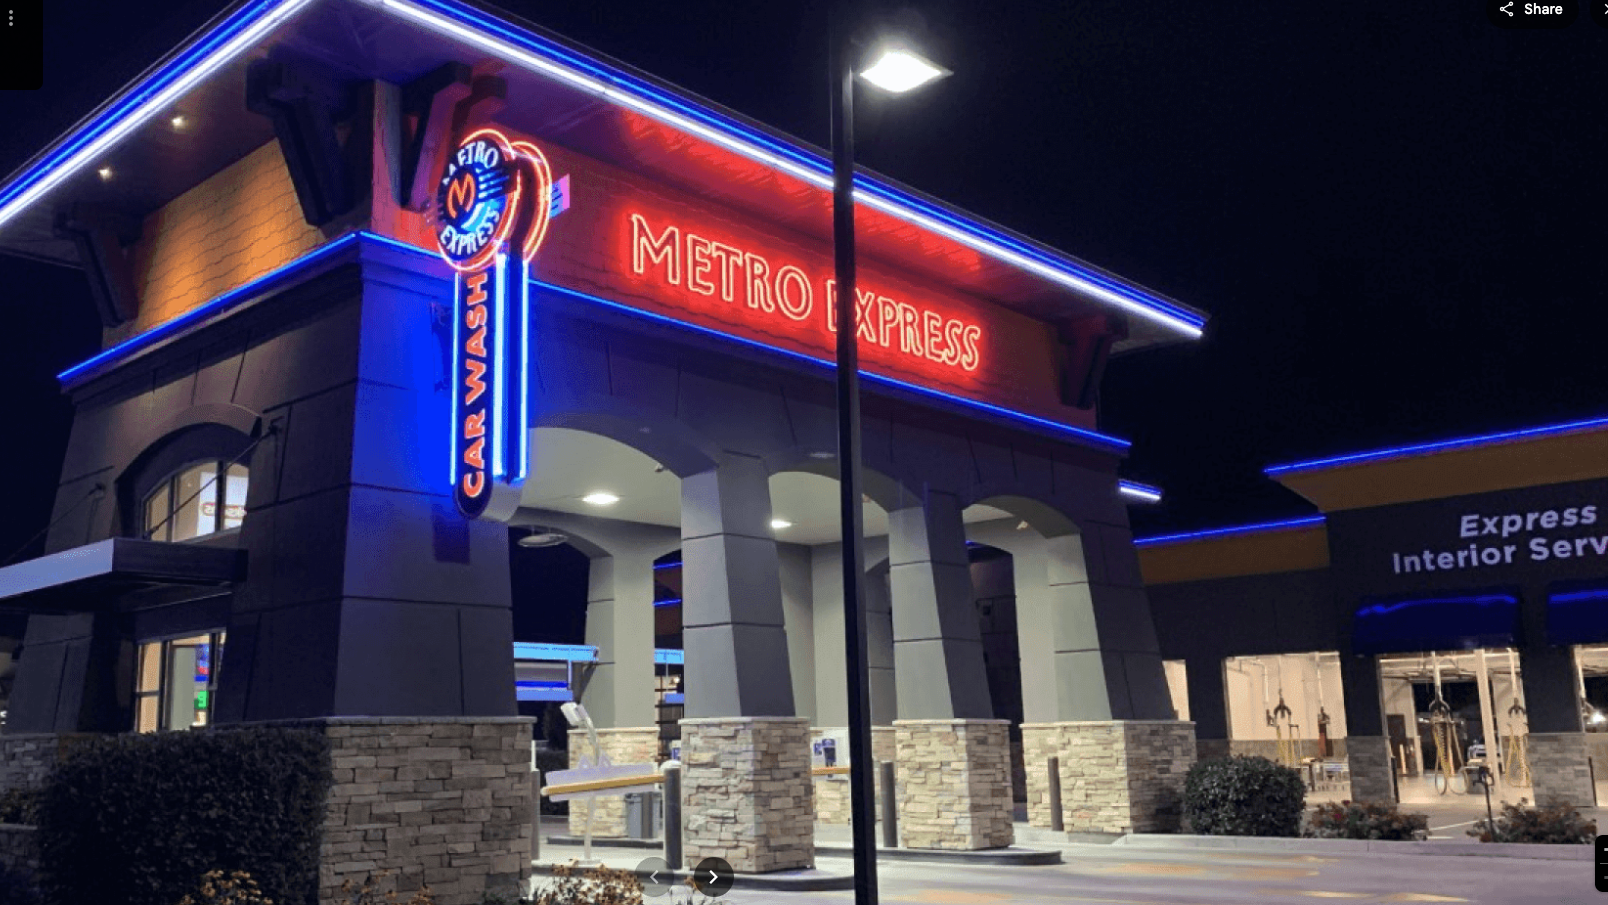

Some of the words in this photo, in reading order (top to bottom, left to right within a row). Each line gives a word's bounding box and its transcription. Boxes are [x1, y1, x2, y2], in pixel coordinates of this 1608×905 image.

[446, 172, 476, 219] M
[440, 206, 500, 256] EXPRESS
[630, 213, 813, 320] METRO
[464, 272, 488, 405] WASH
[463, 408, 487, 498] CAR
[1460, 504, 1598, 538] Express
[1393, 543, 1517, 574] Interior
